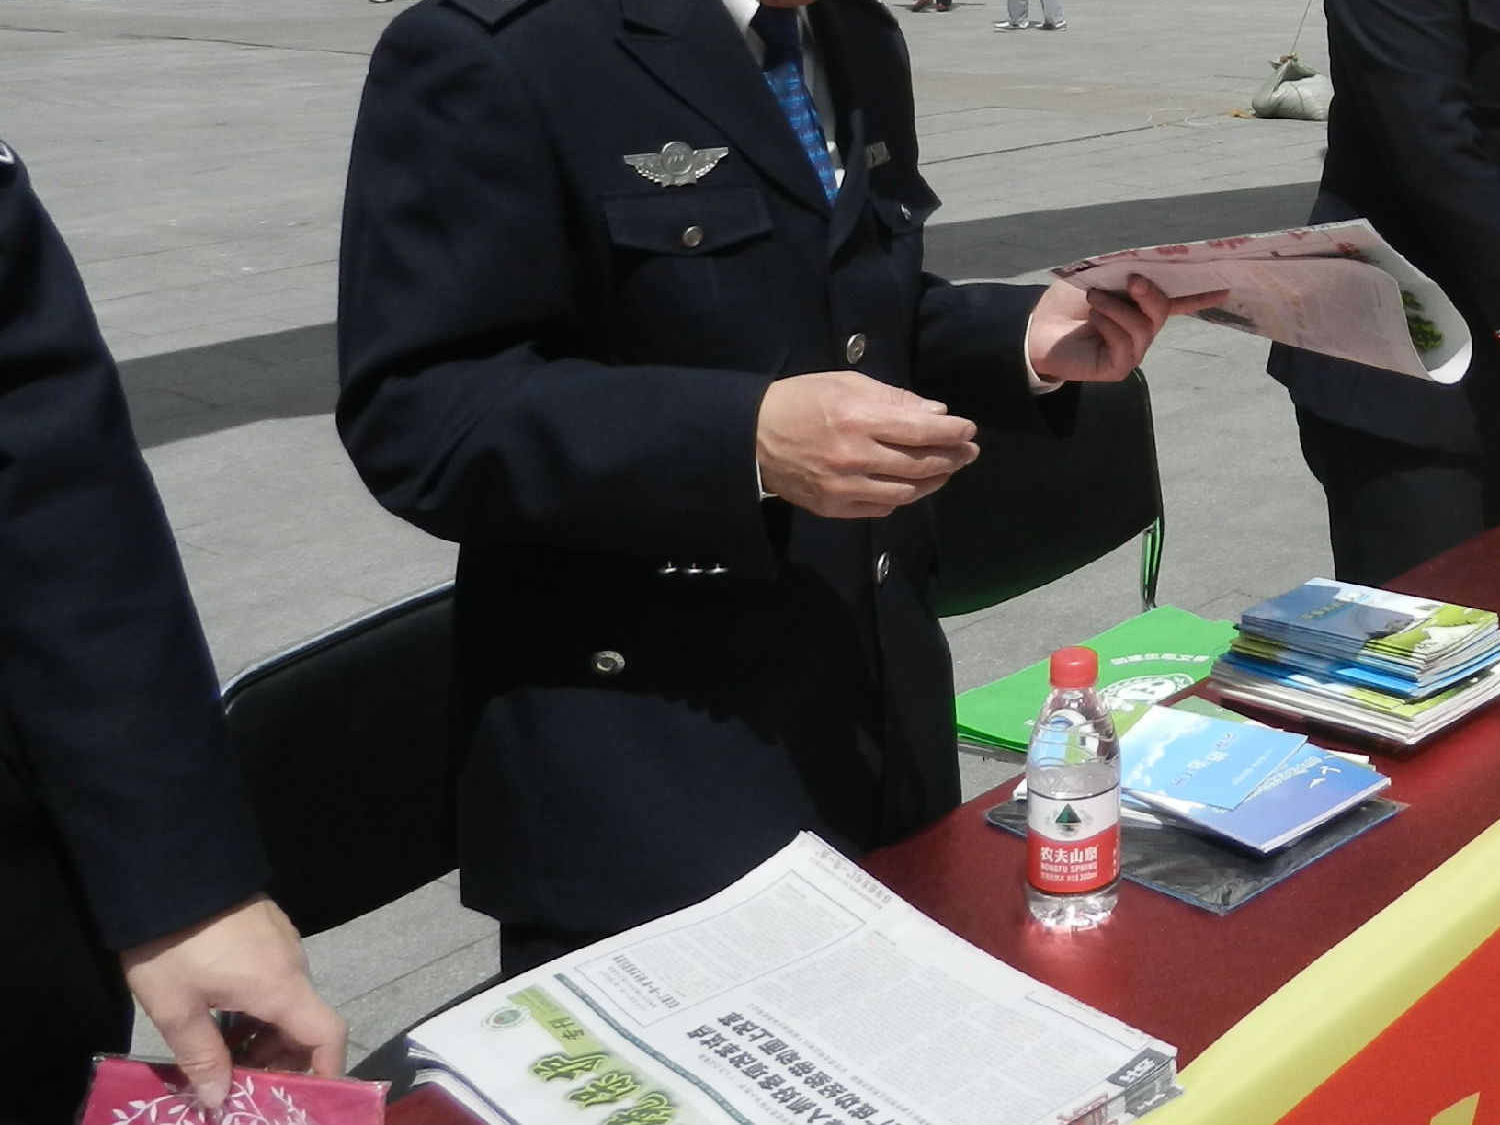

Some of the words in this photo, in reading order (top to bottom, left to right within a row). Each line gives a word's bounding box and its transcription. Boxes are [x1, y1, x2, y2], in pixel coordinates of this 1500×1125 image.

[1040, 845, 1098, 864] 农夫山泉
[718, 1010, 902, 1125] 广成功经验带动面上改革
